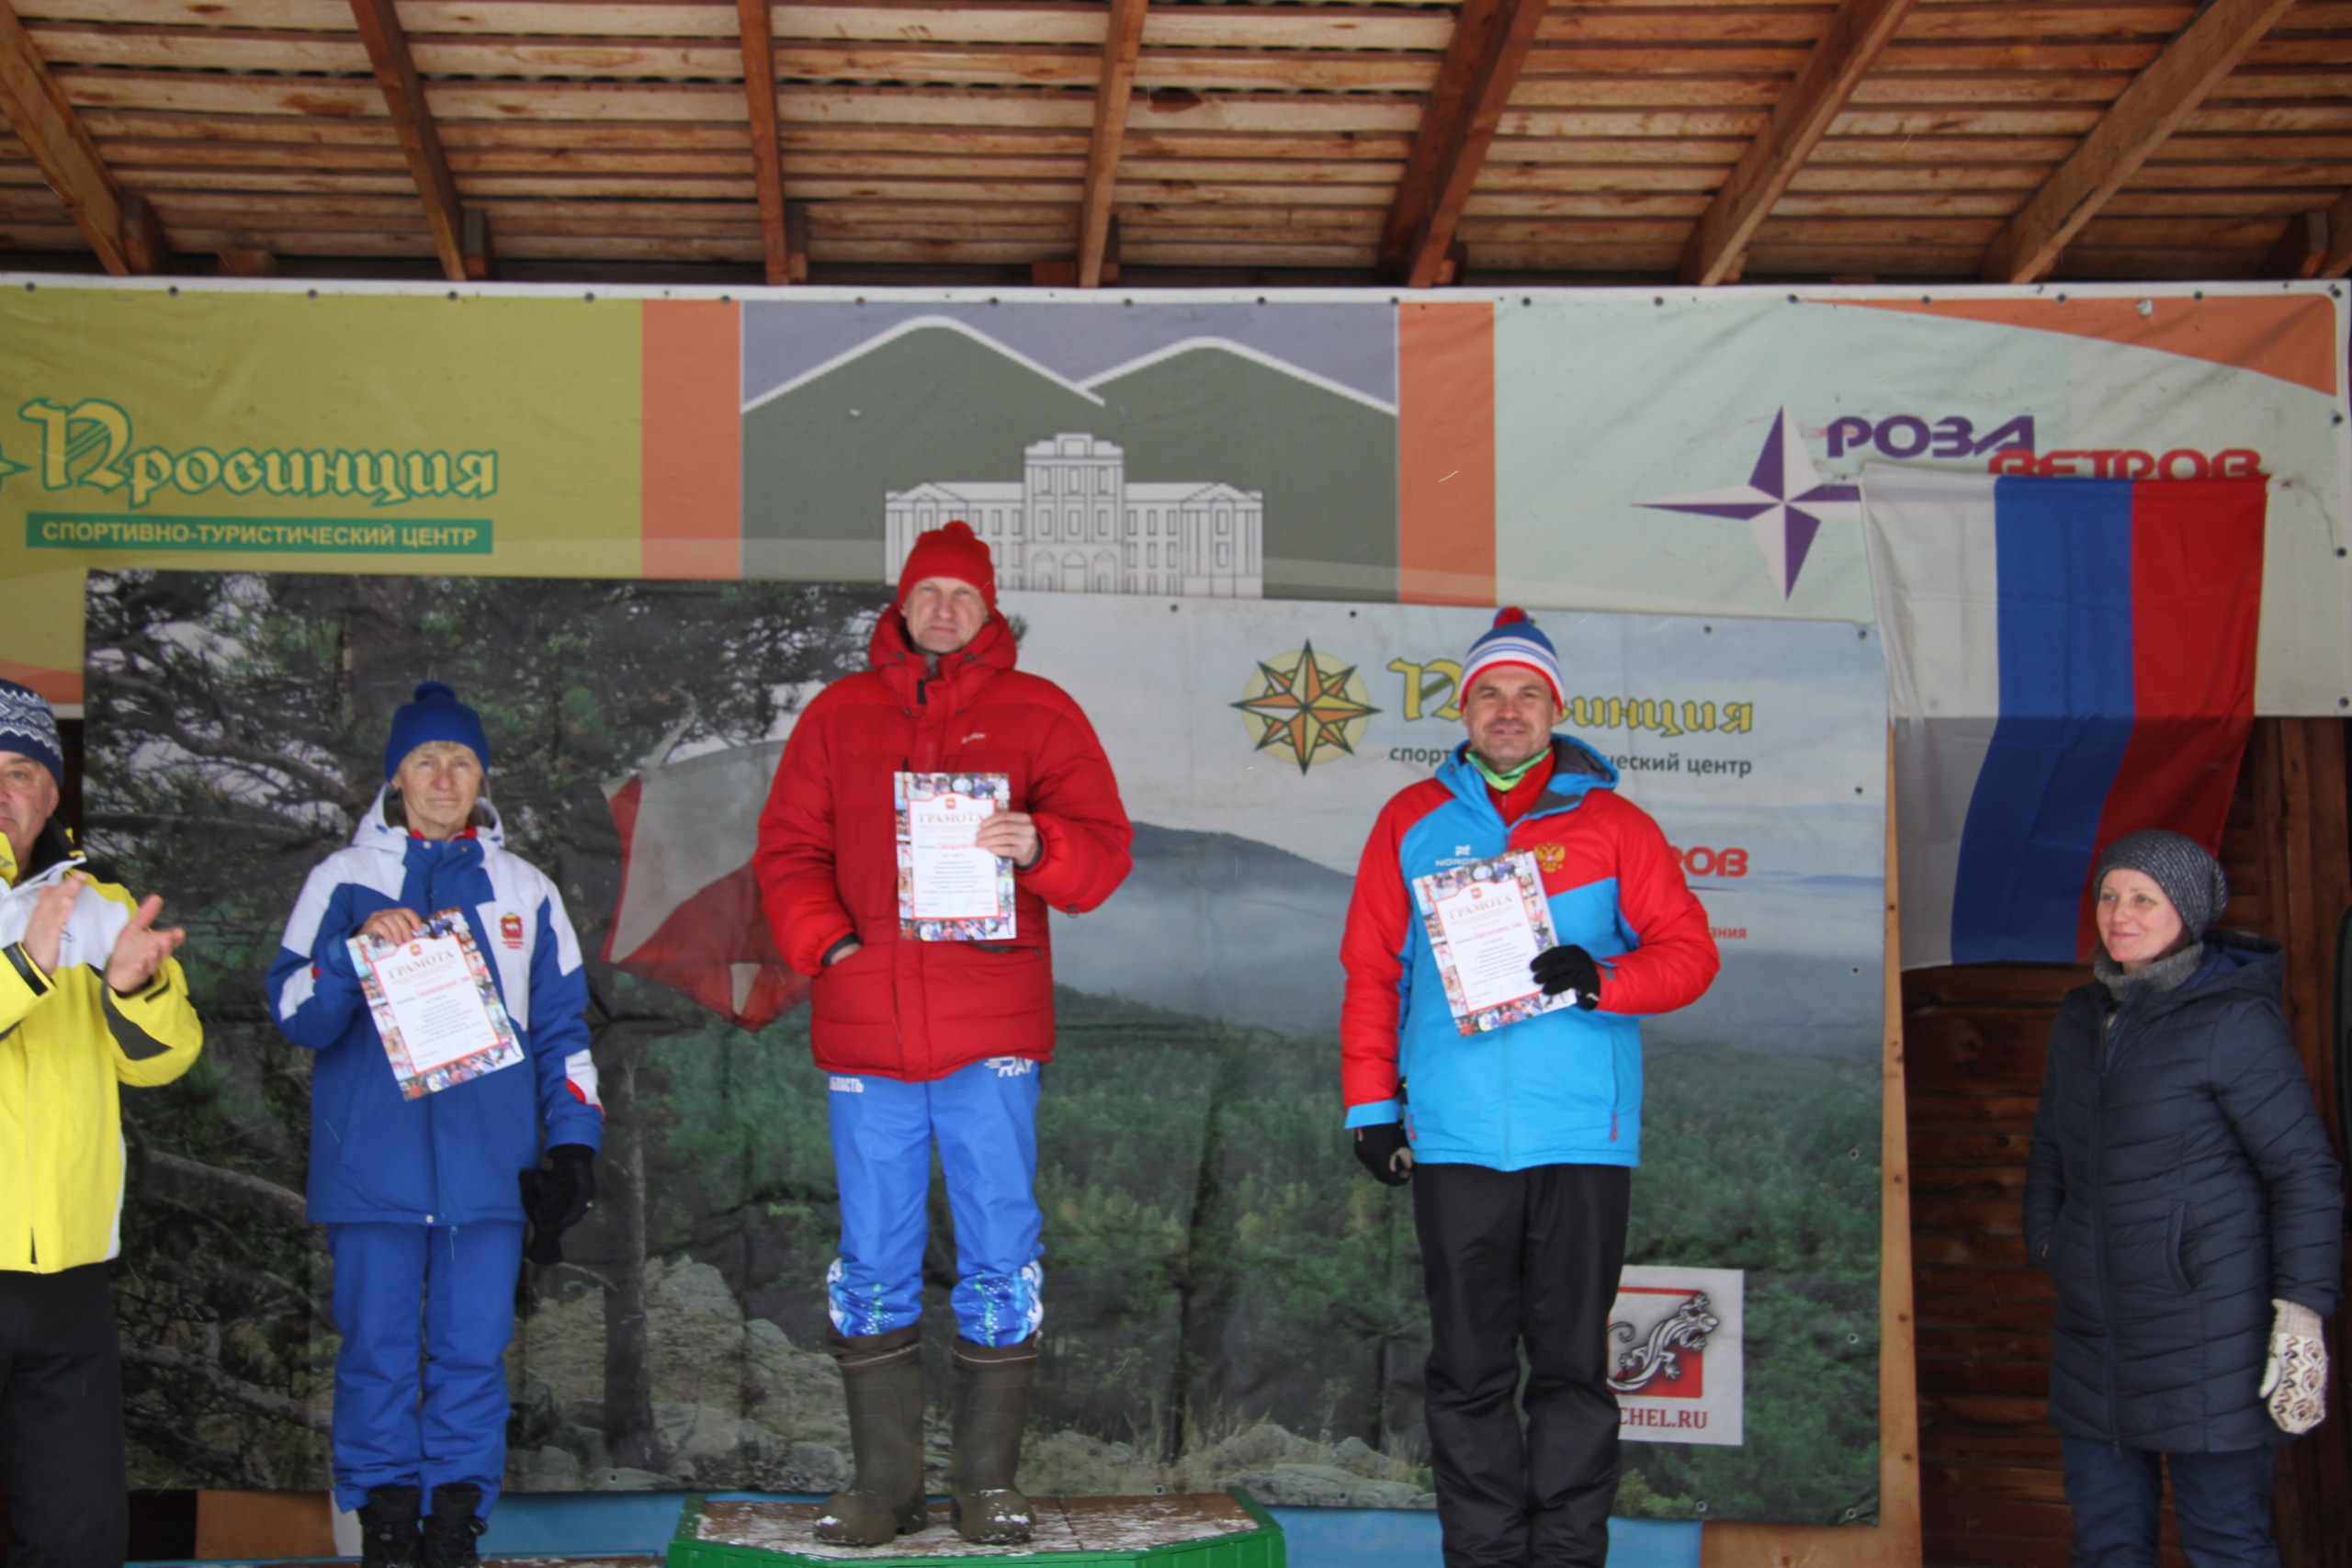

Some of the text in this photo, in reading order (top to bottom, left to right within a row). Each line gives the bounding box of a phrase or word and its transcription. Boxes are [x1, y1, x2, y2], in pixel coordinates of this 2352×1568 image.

[18, 397, 498, 509] Провинция
[1826, 415, 2035, 458] РОЗА
[41, 521, 478, 547] СПОРТИВНО-ТУРИСТИЧЕСКИЙ ЦЕНТР
[1386, 658, 1754, 738] Пинция
[1687, 758, 1752, 778] центр
[1619, 1407, 1708, 1429] CHEL.RU
